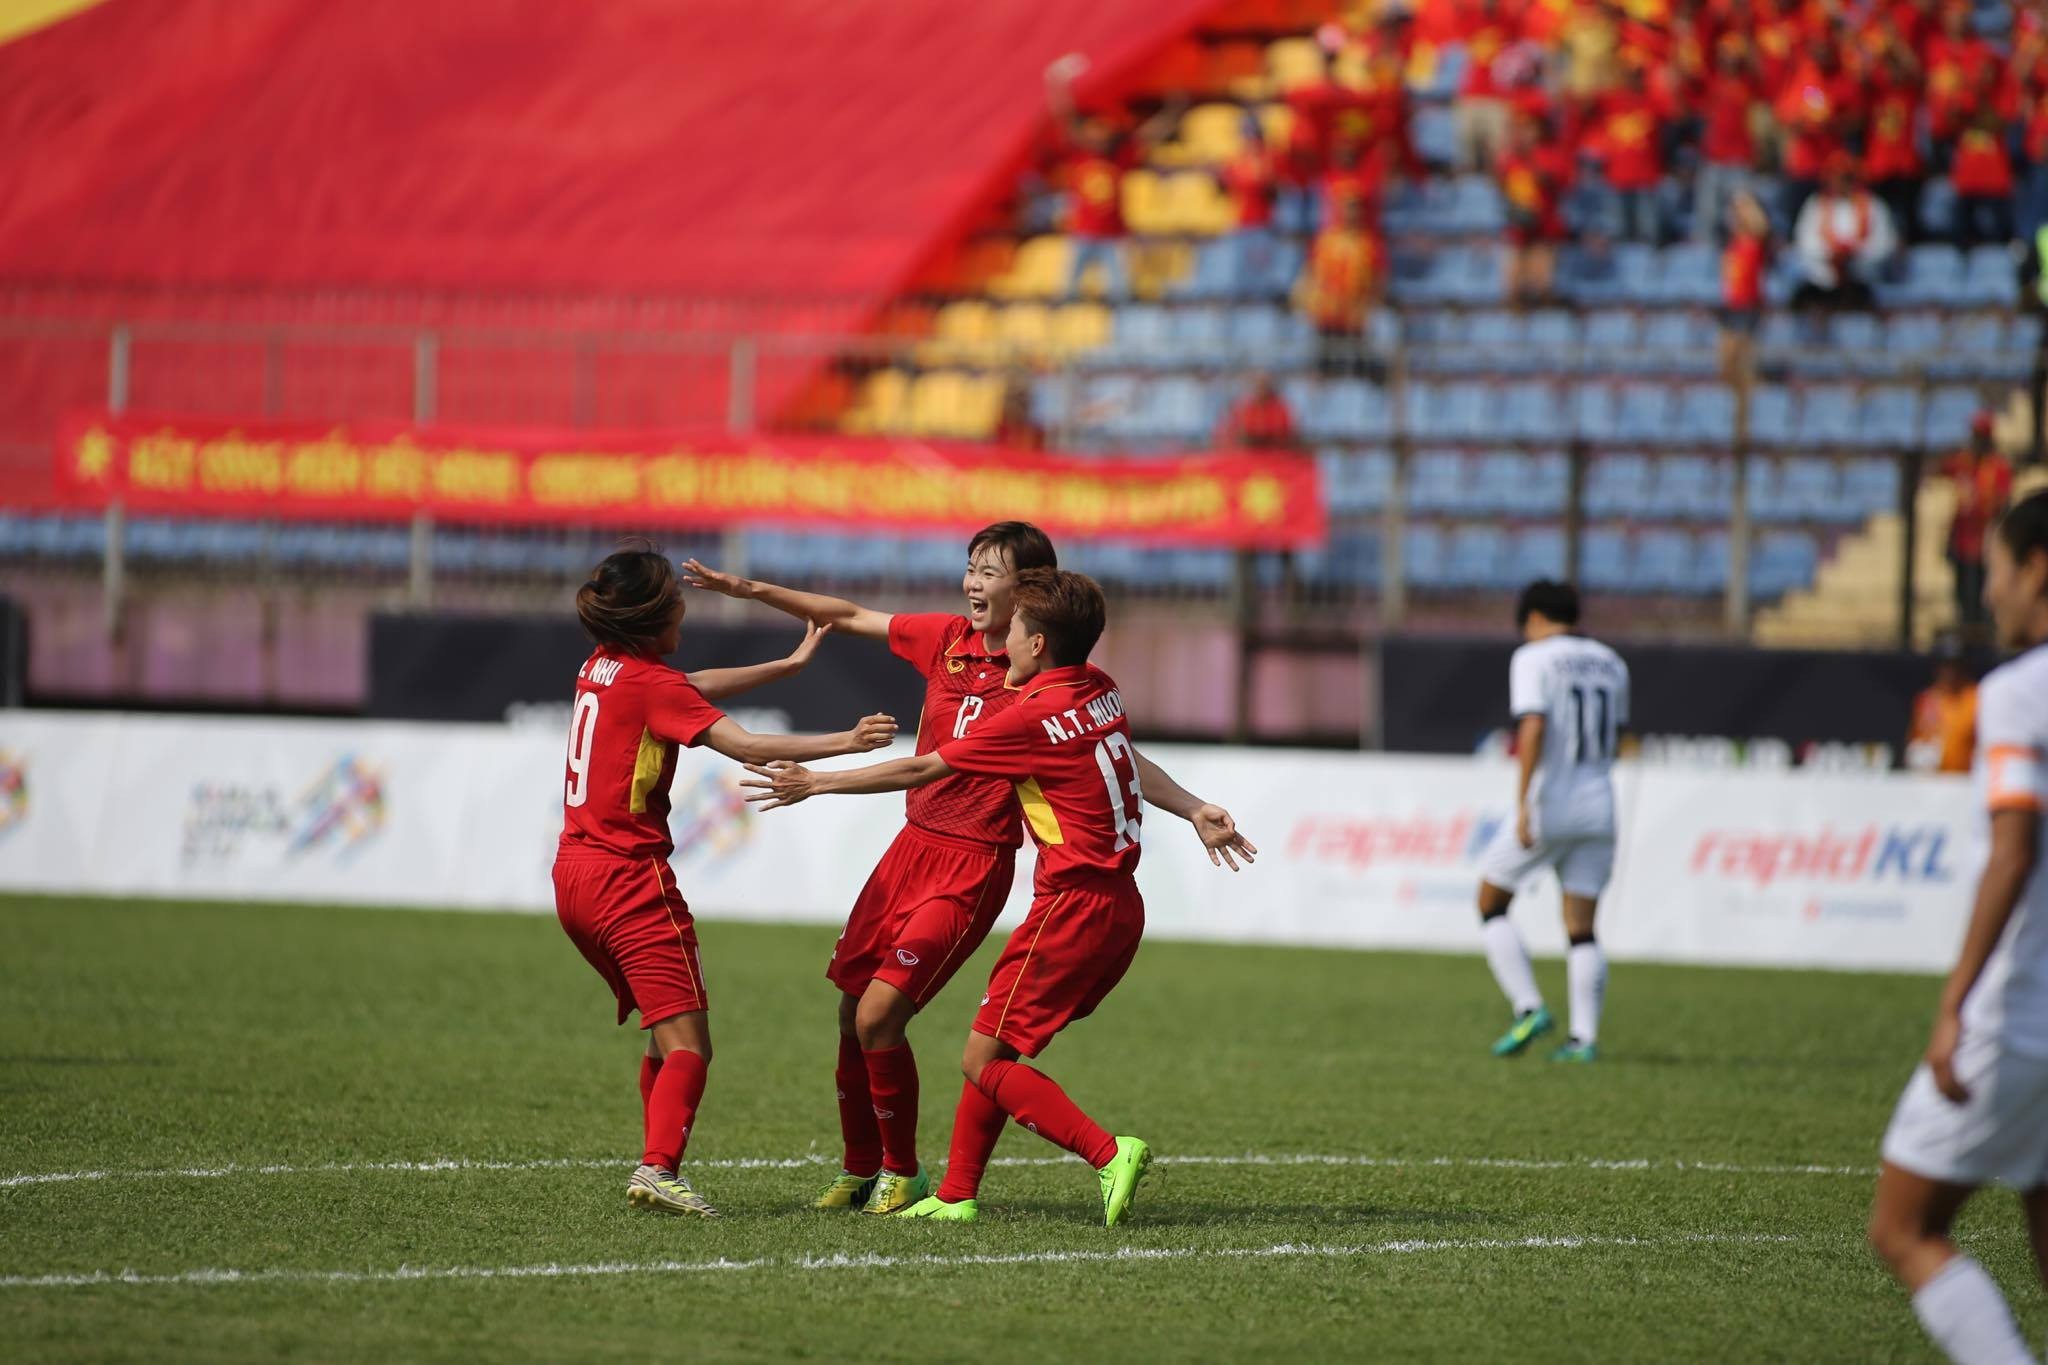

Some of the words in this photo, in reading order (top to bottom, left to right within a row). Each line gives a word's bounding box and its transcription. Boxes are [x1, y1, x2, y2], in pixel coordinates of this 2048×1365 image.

[587, 657, 623, 686] NHU
[565, 689, 599, 808] 9
[952, 695, 984, 739] 12
[1571, 686, 1609, 764] 11
[1095, 731, 1144, 853] 13
